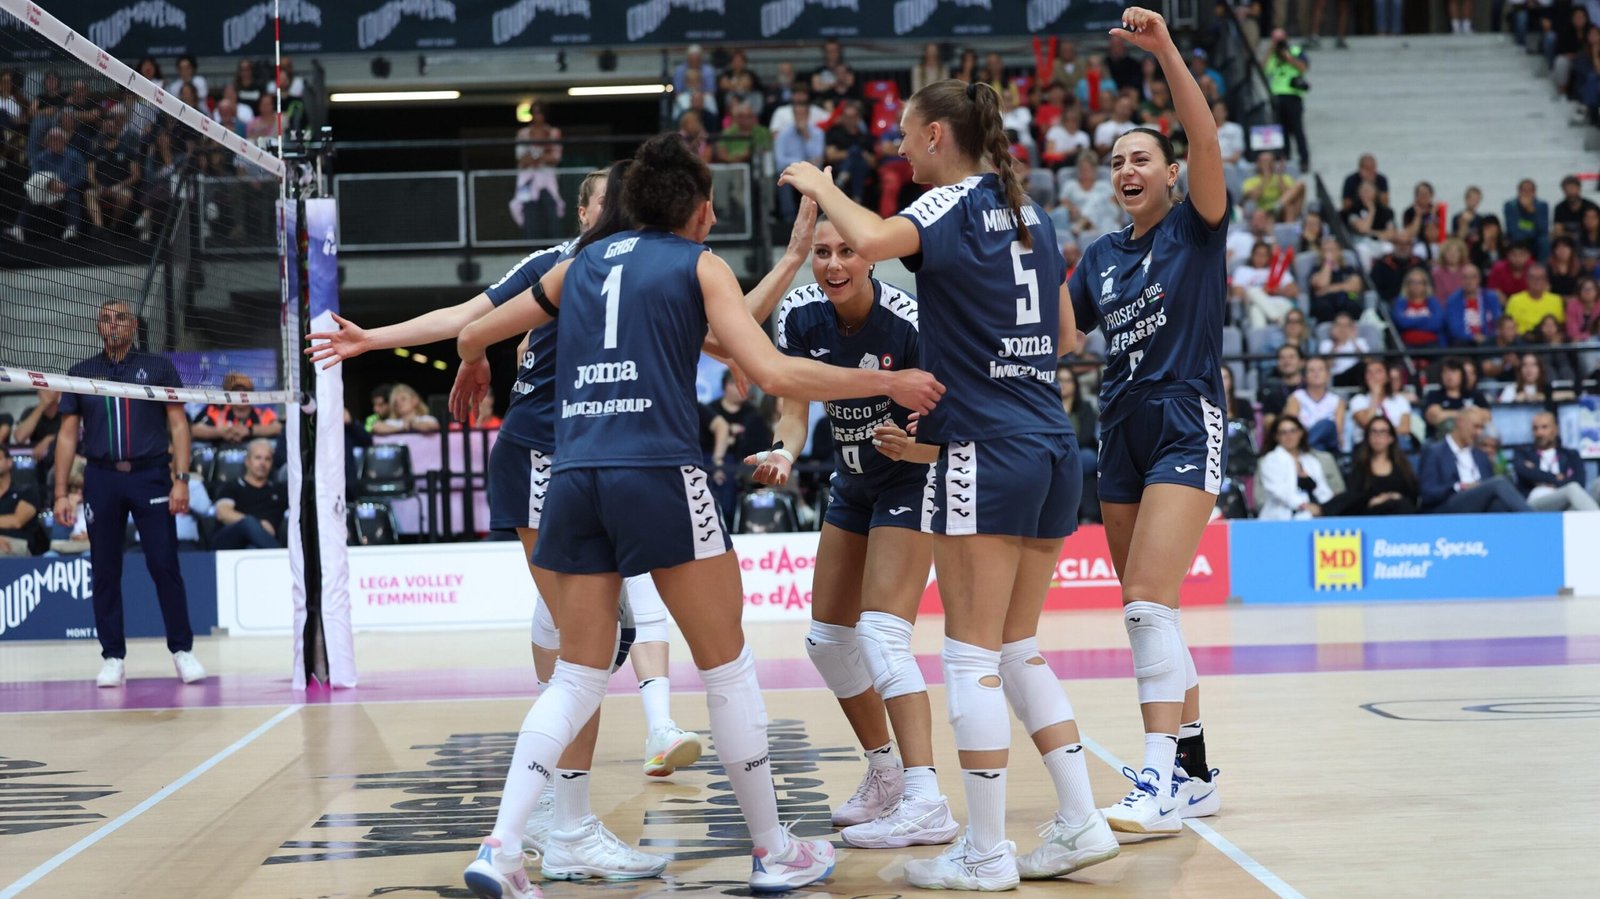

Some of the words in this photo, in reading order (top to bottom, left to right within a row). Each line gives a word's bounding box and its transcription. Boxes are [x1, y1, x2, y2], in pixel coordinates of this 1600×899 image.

[603, 237, 641, 259] GABI
[1011, 241, 1041, 326] 5
[601, 264, 623, 349] 1
[1104, 292, 1145, 331] PROSECO
[1145, 282, 1162, 299] DOC
[603, 398, 652, 414] GROUP
[835, 412, 892, 434] NTONIO
[842, 445, 864, 474] 9
[1320, 549, 1357, 569] MD
[1373, 538, 1431, 558] Buona
[1434, 537, 1489, 560] Spesa,
[360, 576, 400, 590] LEGA
[405, 573, 464, 588] VOLLEY
[367, 591, 459, 605] FEMMINILE
[65, 627, 92, 638] MONT
[528, 760, 551, 781] Jom
[744, 755, 769, 772] Jom
